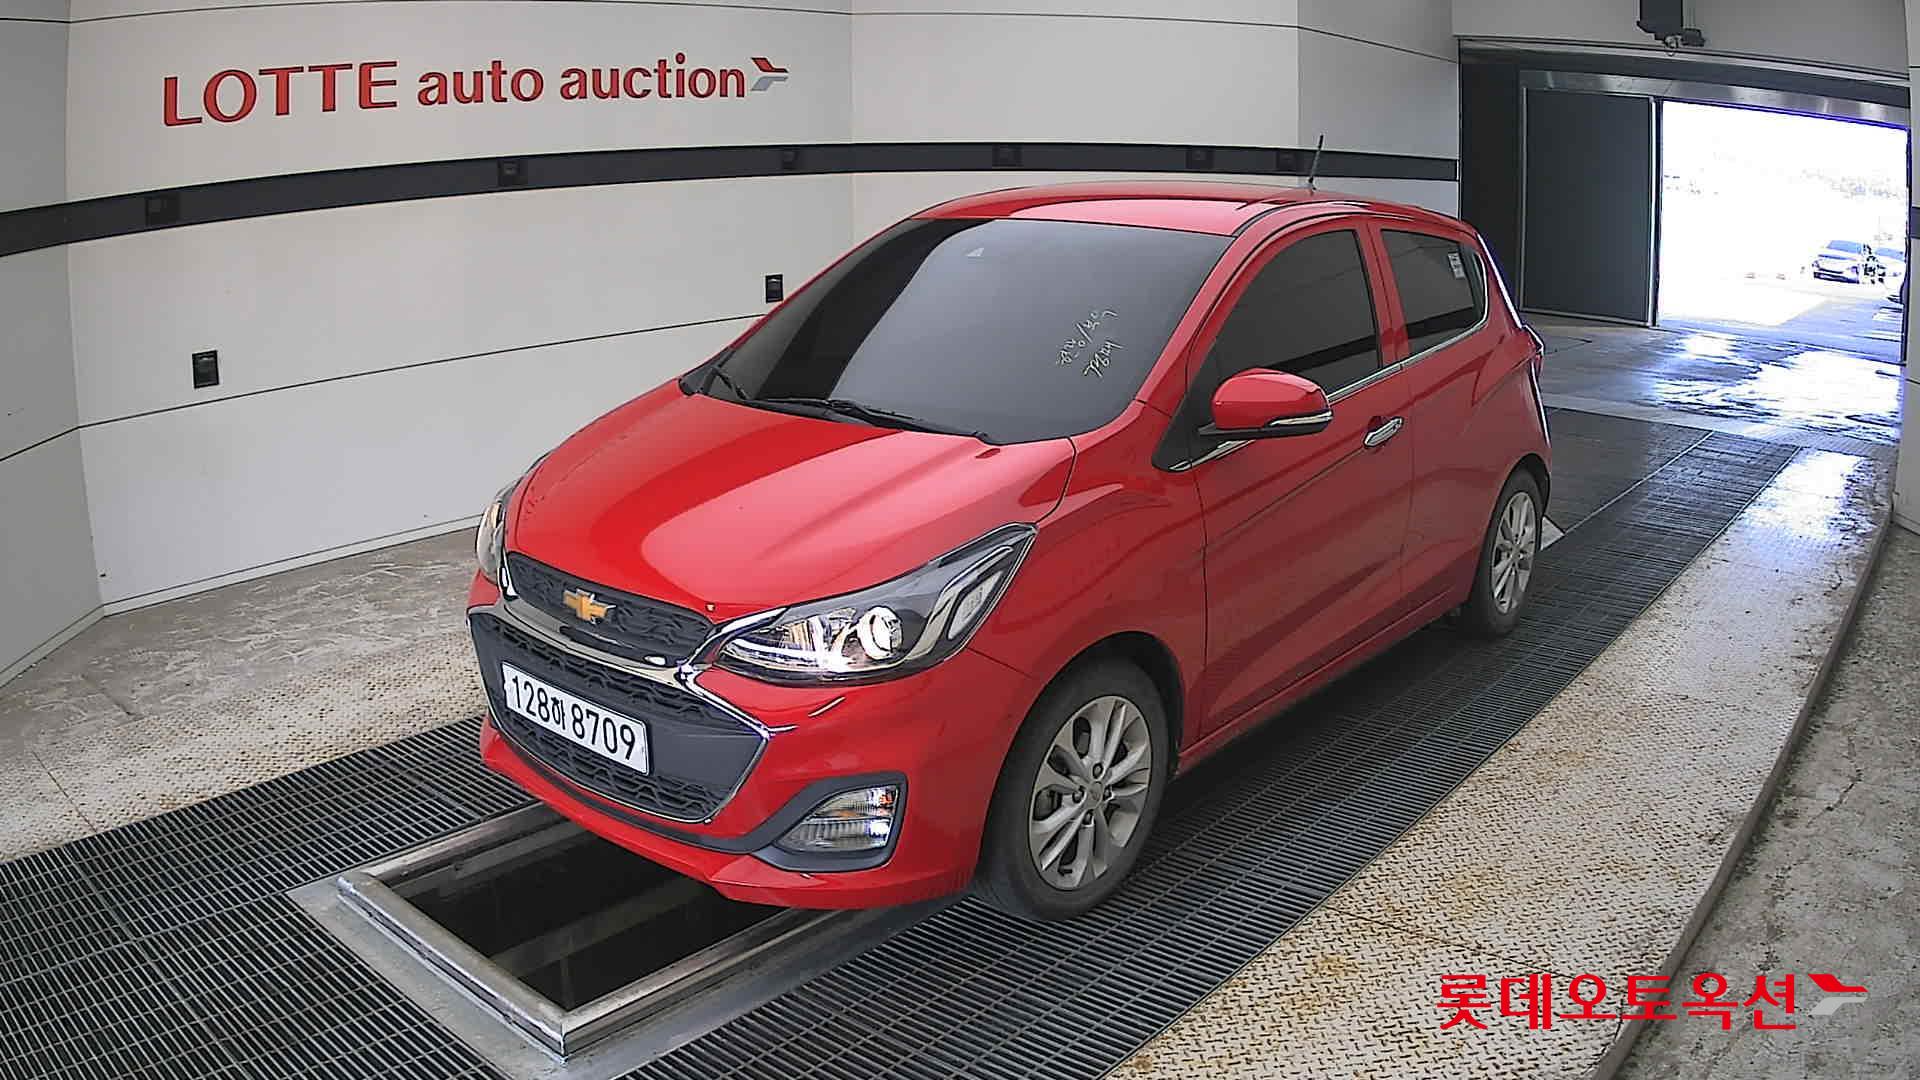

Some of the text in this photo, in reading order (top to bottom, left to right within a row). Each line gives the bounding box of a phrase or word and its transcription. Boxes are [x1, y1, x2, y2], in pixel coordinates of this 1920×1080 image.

[163, 53, 746, 126] LOTTE auto auction
[571, 703, 636, 760] 8709
